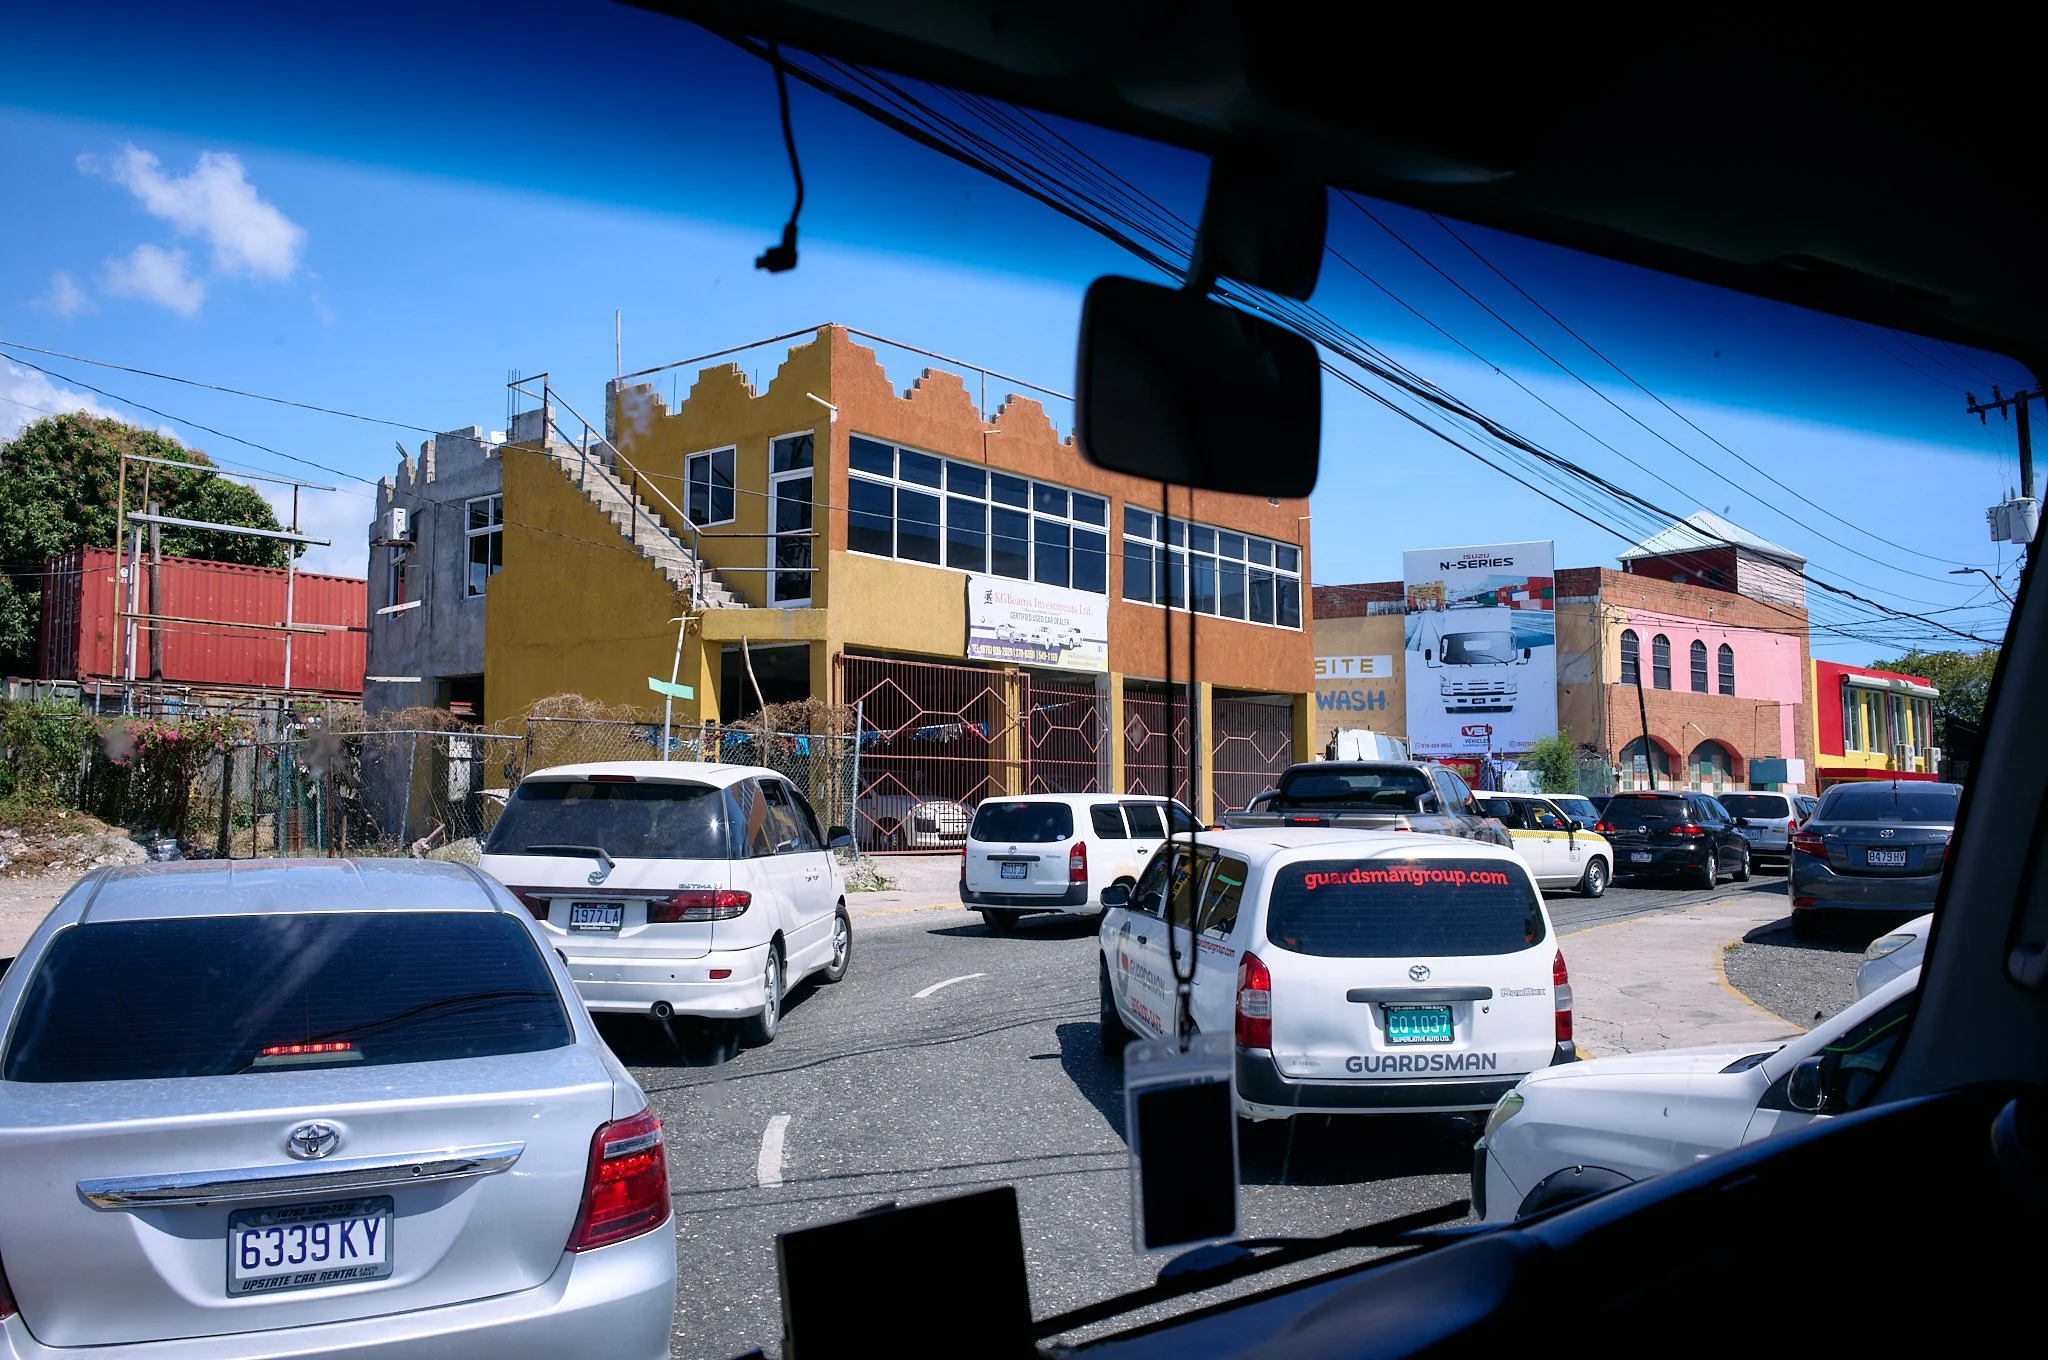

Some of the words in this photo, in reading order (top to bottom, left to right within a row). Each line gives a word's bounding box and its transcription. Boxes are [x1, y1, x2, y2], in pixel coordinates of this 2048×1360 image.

[1440, 558, 1514, 570] N-SERIES
[994, 591, 1033, 607] KGBeams
[1034, 598, 1078, 613] Investments
[1079, 604, 1093, 616] Ltd.
[1010, 611, 1032, 621] CERTIFIED
[1032, 614, 1044, 623] USED
[1045, 616, 1054, 624] CAR
[1054, 618, 1070, 626] DEALER
[1315, 658, 1374, 674] SITE
[1315, 690, 1386, 711] WASH
[1304, 868, 1508, 890] guardsmangroup.com
[1411, 1015, 1448, 1034] 1037
[1345, 1053, 1496, 1073] GUARDSMAN
[241, 1223, 330, 1269] 6339
[340, 1217, 381, 1259] KY
[242, 1276, 292, 1290] UPSTATE
[293, 1272, 316, 1284] CAR
[319, 1268, 358, 1281] RENTAL
